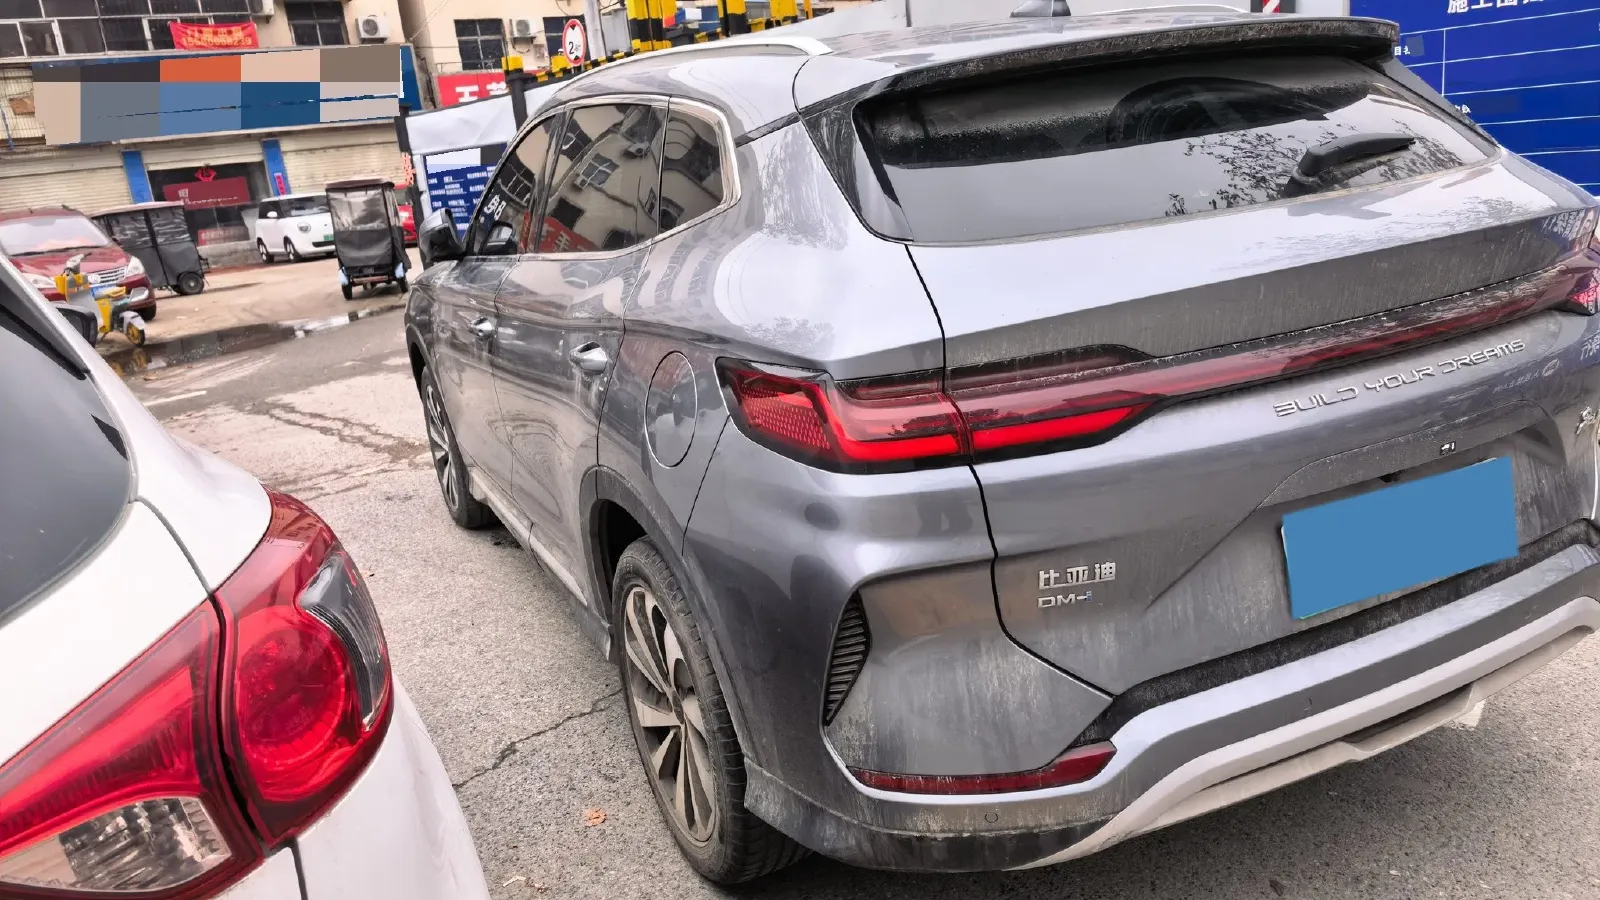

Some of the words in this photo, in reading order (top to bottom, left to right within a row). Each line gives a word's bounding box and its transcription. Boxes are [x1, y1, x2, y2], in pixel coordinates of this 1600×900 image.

[1273, 386, 1359, 418] BUILD
[1364, 365, 1436, 393] YOUR
[1437, 339, 1526, 375] DREAMS
[1038, 561, 1116, 590] 比亚迪
[1037, 590, 1093, 609] DM-i
